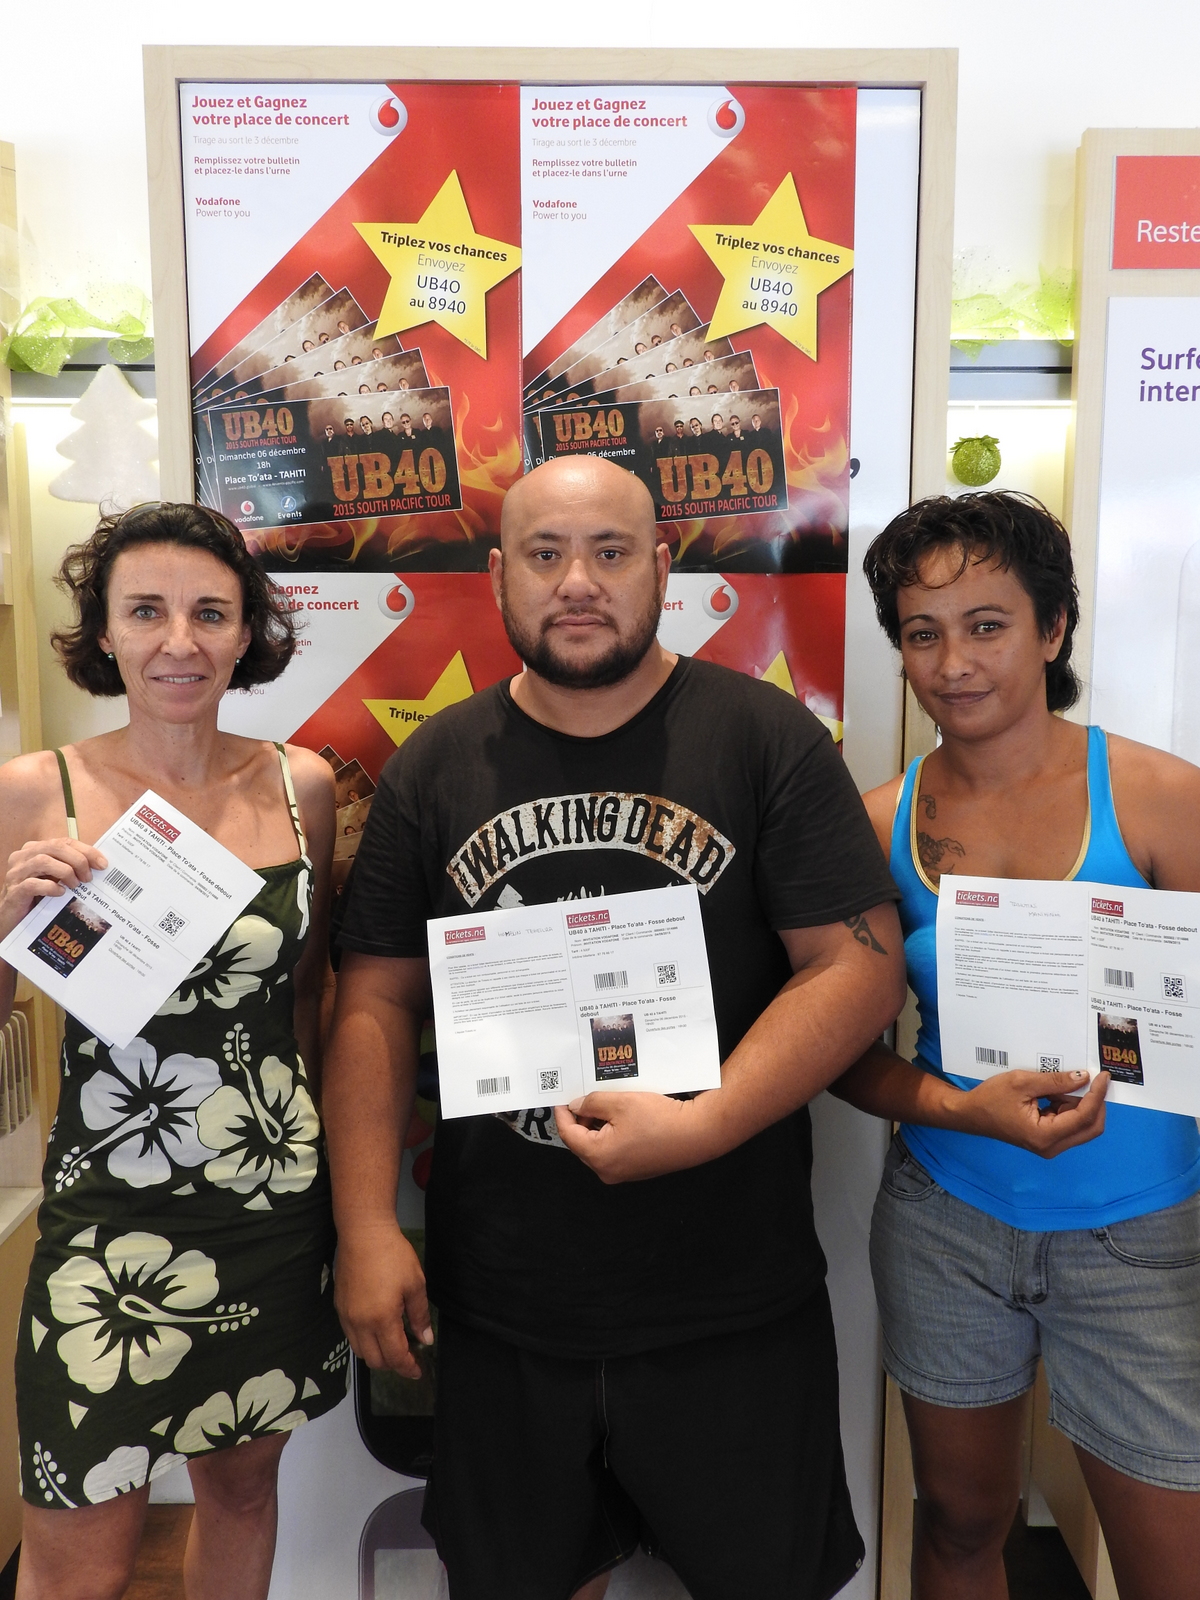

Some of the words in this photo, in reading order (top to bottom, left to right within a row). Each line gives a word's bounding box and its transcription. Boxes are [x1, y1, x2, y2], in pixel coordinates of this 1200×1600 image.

[192, 96, 234, 108] Jouez
[236, 96, 252, 108] et
[254, 95, 308, 111] Gagnez
[532, 98, 573, 111] Jouez
[576, 99, 591, 111] et
[593, 98, 646, 114] Gagnez
[192, 114, 231, 126] votre
[234, 113, 272, 128] place
[274, 113, 292, 126] de
[295, 114, 350, 126] concert
[532, 116, 570, 128] votre
[572, 115, 611, 130] place
[613, 115, 631, 127] de
[633, 115, 688, 127] concert
[193, 136, 216, 146] Tirage
[228, 136, 244, 144] sort
[245, 136, 253, 144] le
[254, 136, 259, 144] 3
[260, 136, 299, 144] décembre
[532, 138, 555, 148] Tirage
[583, 138, 591, 146] le
[592, 138, 598, 146] 3
[598, 138, 637, 146] décembre
[194, 156, 242, 166] Remplissez
[244, 157, 266, 165] votre
[267, 156, 300, 165] bulletin
[532, 159, 580, 168] Remplissez
[604, 159, 637, 167] bulletin
[194, 167, 203, 175] et
[204, 166, 242, 176] placez-le
[244, 166, 264, 175] dans
[265, 166, 290, 175] l'urne
[532, 169, 541, 177] et
[542, 169, 580, 178] placez-le
[582, 169, 602, 177] dans
[603, 169, 628, 177] l'urne
[195, 197, 241, 206] Vodafone
[532, 200, 578, 208] Vodafone
[196, 208, 222, 217] Power
[223, 209, 232, 217] to
[234, 210, 251, 219] you
[532, 210, 558, 220] Power
[560, 212, 569, 220] to
[570, 212, 587, 222] you
[380, 231, 426, 248] Triplez
[428, 241, 451, 253] vos
[453, 244, 508, 262] chances
[716, 233, 760, 251] Triplez
[762, 243, 785, 255] vos
[787, 246, 840, 264] chances
[418, 253, 466, 273] Envoyez
[751, 255, 799, 275] Envoyez
[410, 298, 425, 308] au
[428, 296, 466, 315] 8940
[742, 300, 757, 310] au
[760, 298, 798, 316] 8940
[222, 407, 294, 441] UB40
[552, 408, 625, 442] UB40
[226, 441, 239, 450] 2015
[240, 439, 260, 449] SOUTH
[260, 437, 280, 446] PACIFIC
[280, 435, 297, 445] TOUR
[556, 442, 569, 452] 2015
[570, 440, 590, 450] SOUTH
[590, 438, 610, 448] PACIFIC
[610, 436, 627, 446] TOUR
[219, 451, 256, 462] Dimanche
[257, 450, 267, 458] 06
[268, 446, 306, 457] décembre
[598, 448, 636, 458] décembre
[256, 461, 271, 470] 18h
[224, 476, 246, 484] Place
[279, 469, 306, 479] TAHITI
[326, 447, 447, 502] UB40
[656, 448, 774, 502] UB40
[332, 503, 355, 516] 2015
[356, 500, 388, 514] SOUTH
[390, 496, 424, 511] PACIFIC
[424, 494, 452, 508] TOUR
[660, 504, 683, 518] 2015
[684, 500, 716, 515] SOUTH
[718, 497, 751, 512] PACIFIC
[752, 494, 778, 508] TOUR
[234, 515, 264, 524] vodafone
[277, 510, 303, 520] Events
[307, 600, 360, 610] concert
[248, 688, 265, 696] you
[140, 808, 178, 839] tickets.nc
[460, 796, 620, 890] WALKING
[624, 796, 726, 885] DEAD
[130, 816, 145, 830] UB40
[148, 830, 166, 846] TAHITI
[167, 846, 182, 860] Place
[199, 871, 215, 886] Fosse
[214, 882, 233, 900] debout
[452, 862, 476, 898] THE
[957, 891, 998, 903] tickets.nc
[1092, 900, 1123, 912] tickets.nc
[92, 893, 110, 910] TAHITI
[112, 909, 126, 923] Place
[144, 934, 160, 950] Fosse
[568, 911, 609, 924] tickets.nc
[445, 928, 484, 940] tickets.nc
[568, 927, 584, 936] UB40
[611, 922, 626, 930] Place
[1176, 924, 1198, 933] debout
[46, 924, 86, 958] UB40
[580, 1004, 594, 1012] UB40
[600, 1002, 618, 1010] TAHITI
[1127, 1004, 1142, 1012] Place
[1164, 1010, 1182, 1018] Fosse
[597, 1044, 633, 1062] UB40
[1102, 1044, 1138, 1065] UB40
